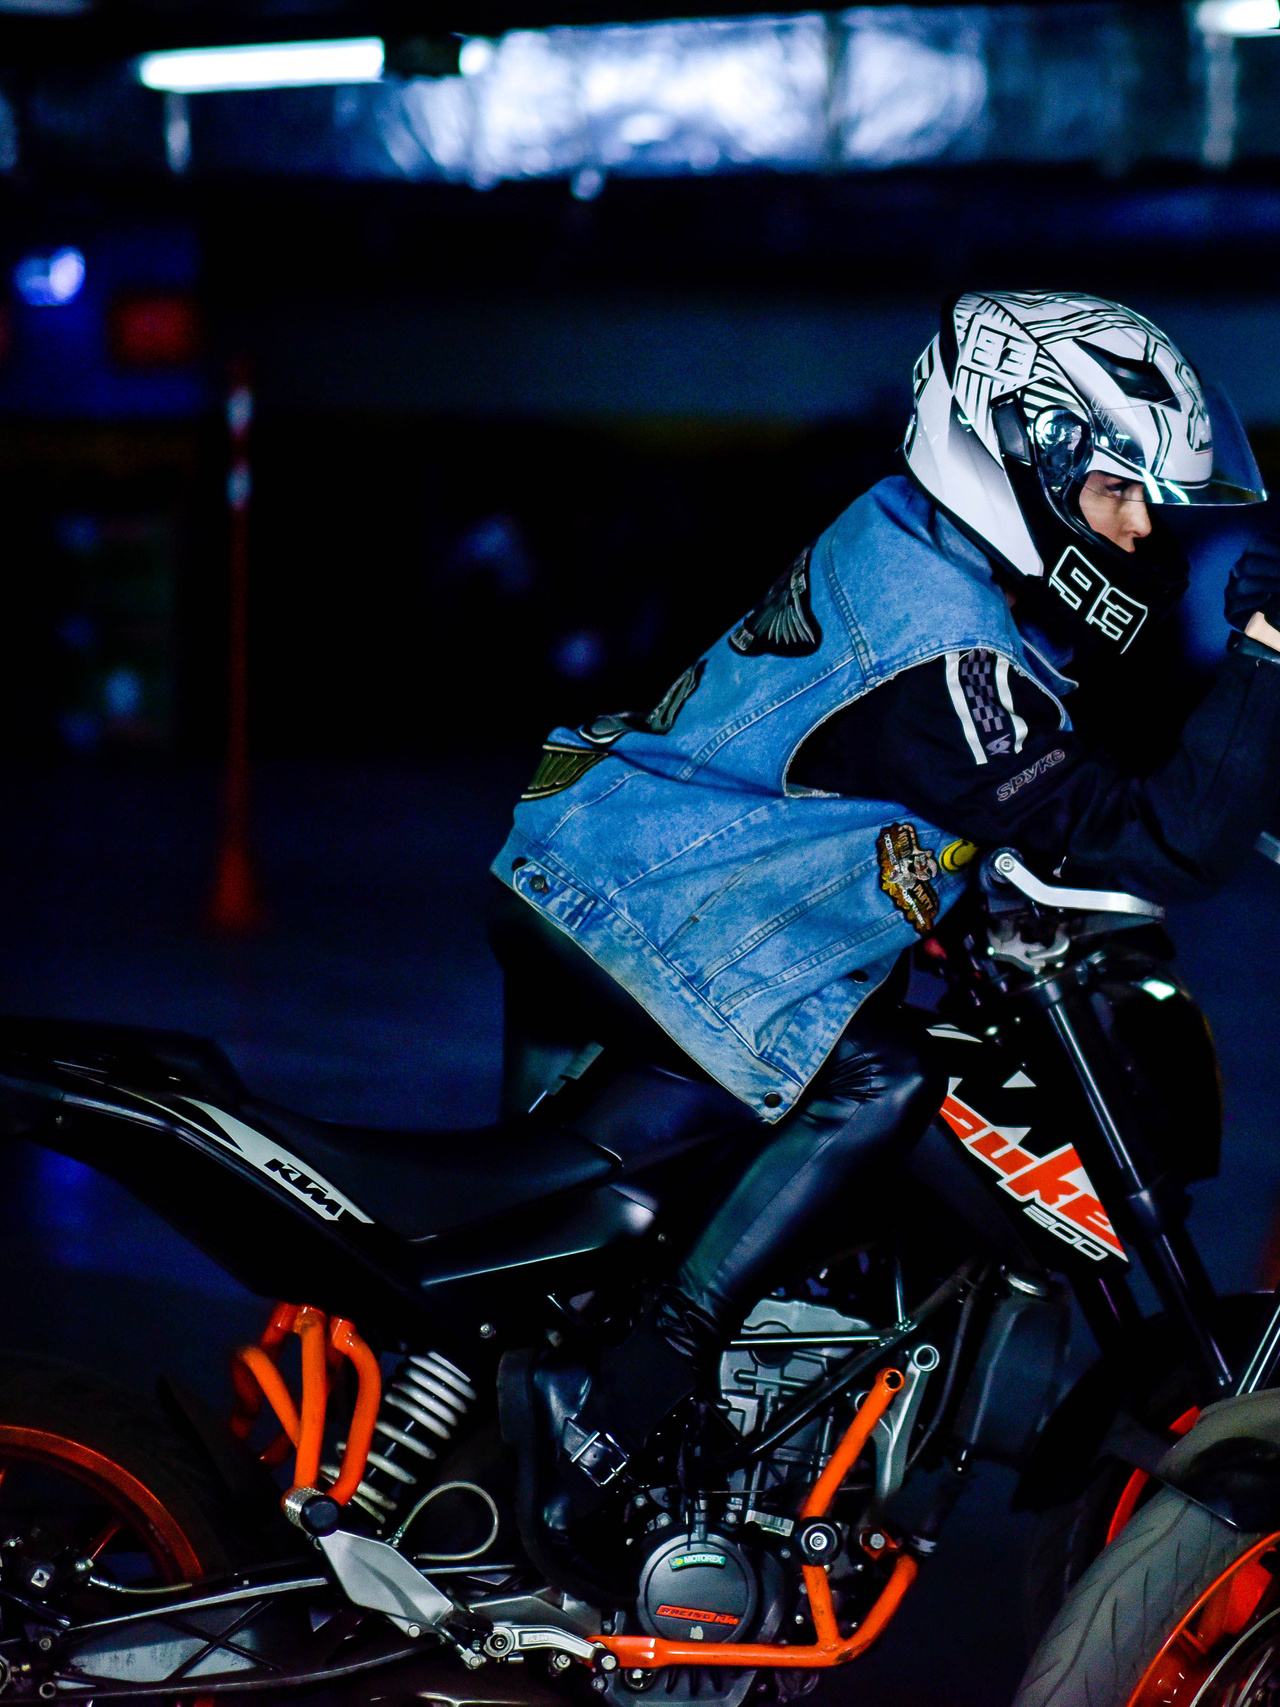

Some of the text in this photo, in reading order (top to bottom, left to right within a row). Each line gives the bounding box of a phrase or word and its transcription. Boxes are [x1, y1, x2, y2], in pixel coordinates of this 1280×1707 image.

[1048, 545, 1149, 655] 93
[264, 1158, 343, 1217] KTM
[1022, 1203, 1110, 1262] 200
[683, 1553, 725, 1565] MOTOREX
